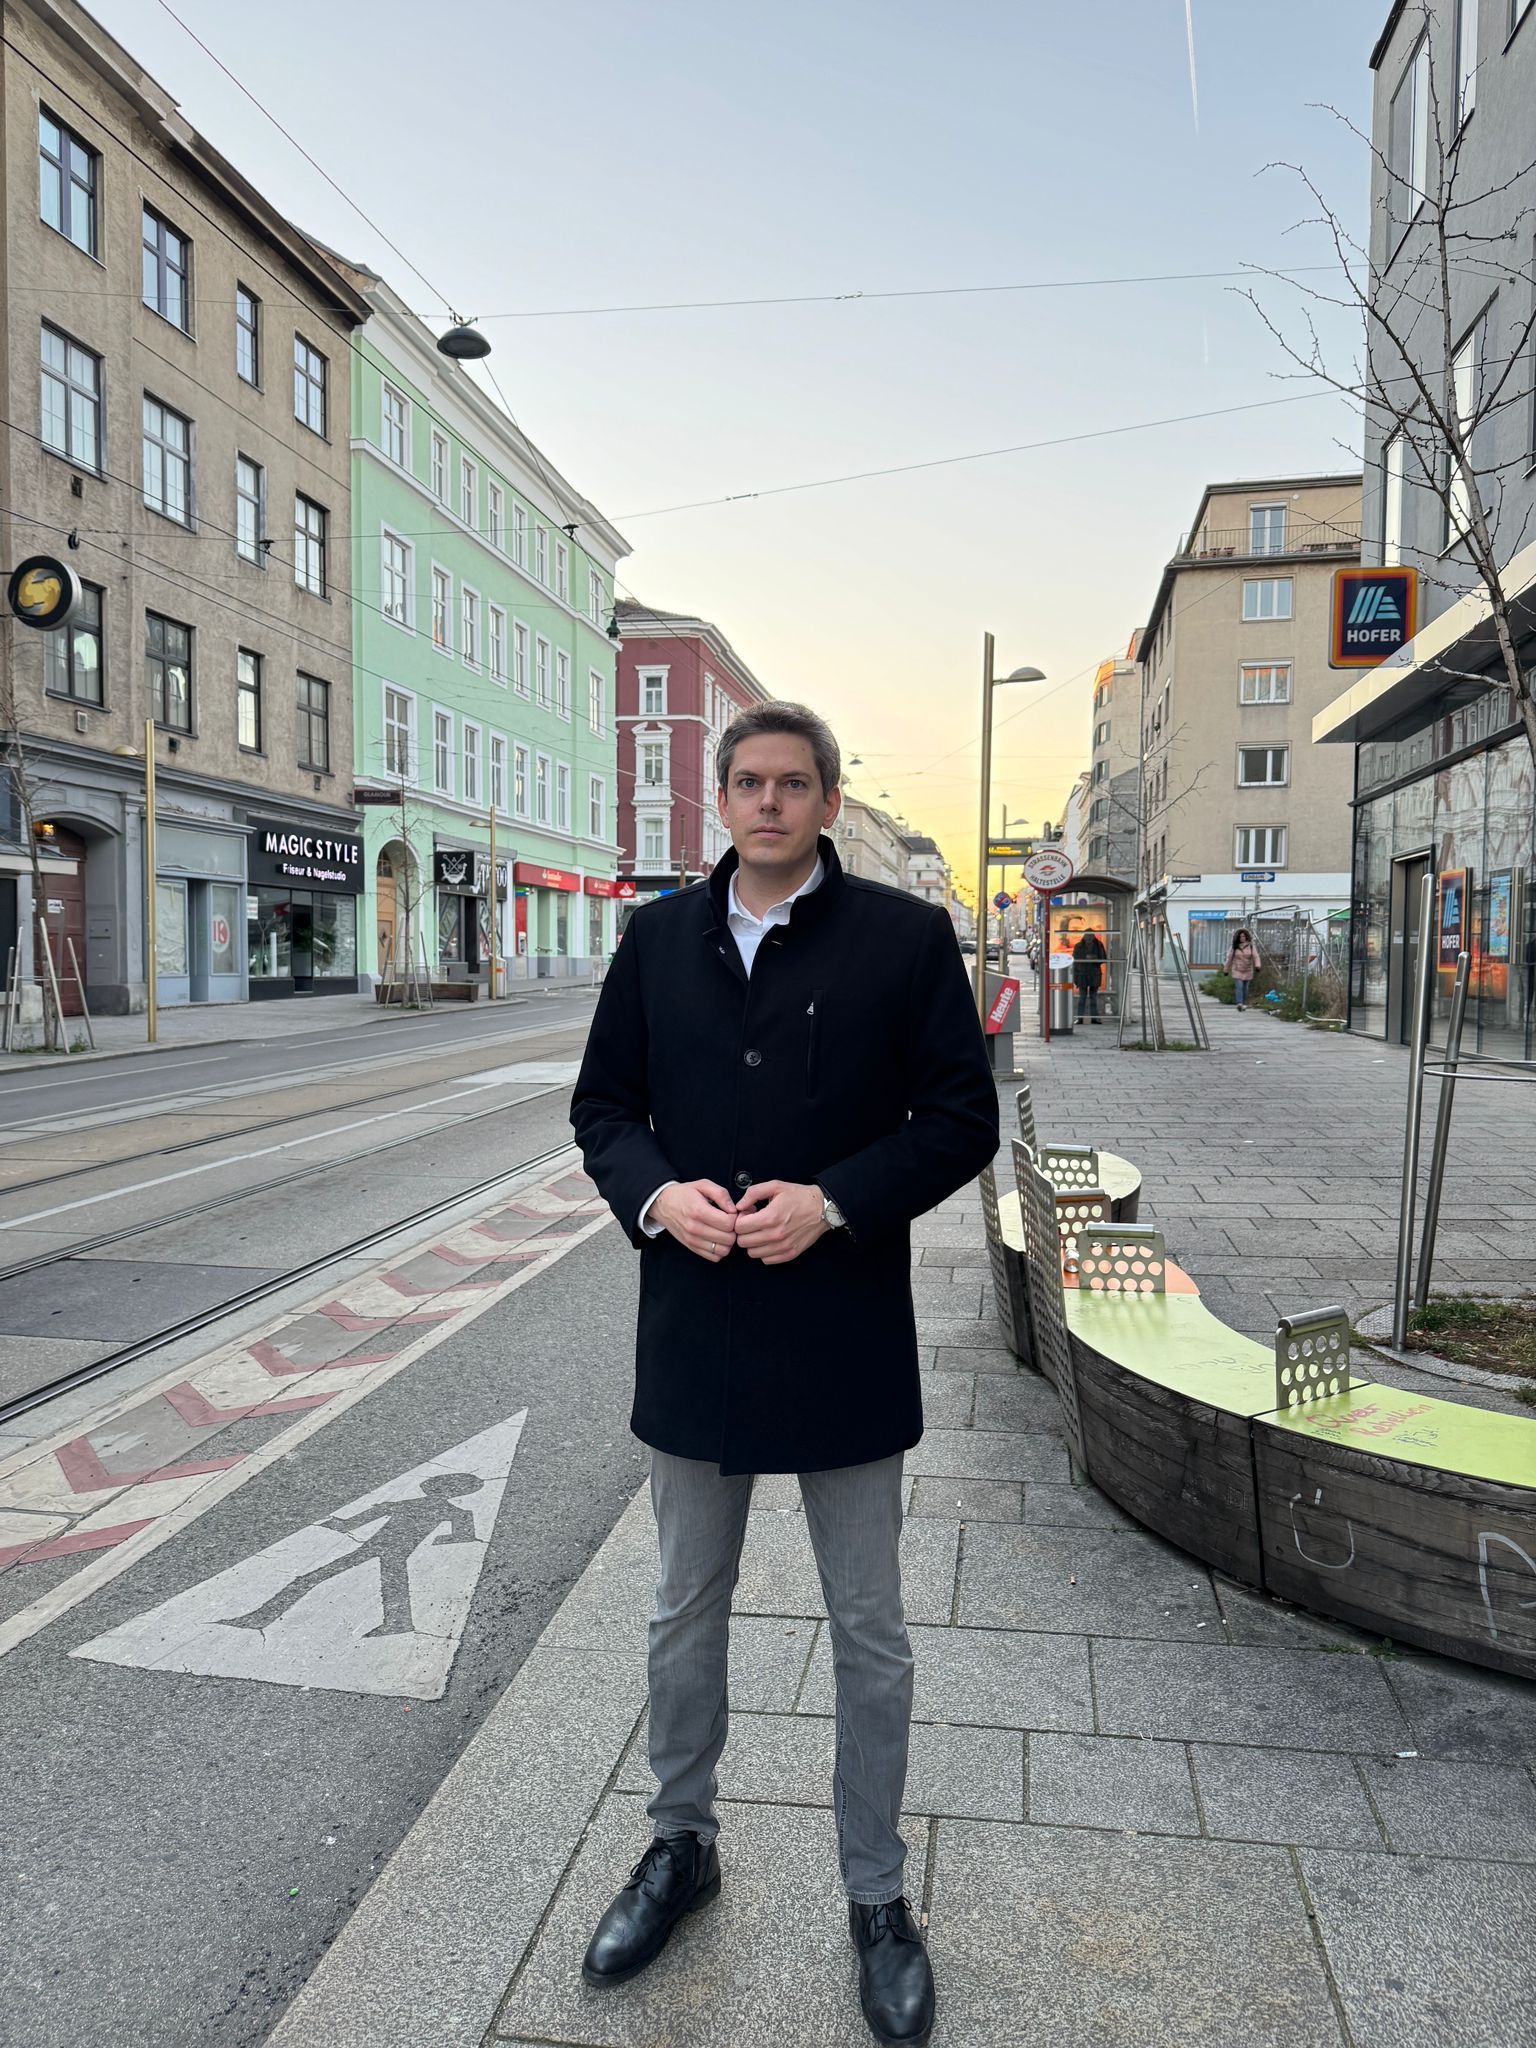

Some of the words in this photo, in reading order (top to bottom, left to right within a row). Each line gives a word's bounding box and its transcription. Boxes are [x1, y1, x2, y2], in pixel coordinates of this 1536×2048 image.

[1346, 629, 1401, 642] HOFER
[265, 831, 313, 858] MAGIC
[315, 839, 358, 864] STYLE
[1028, 854, 1068, 869] STRASSENBAHN
[282, 863, 305, 876] Friseur
[306, 866, 312, 877] &
[313, 867, 346, 881] Nagelstudio
[1030, 874, 1066, 886] HALTESTELLE
[1442, 934, 1460, 949] HOFER
[990, 987, 1013, 1023] Heute
